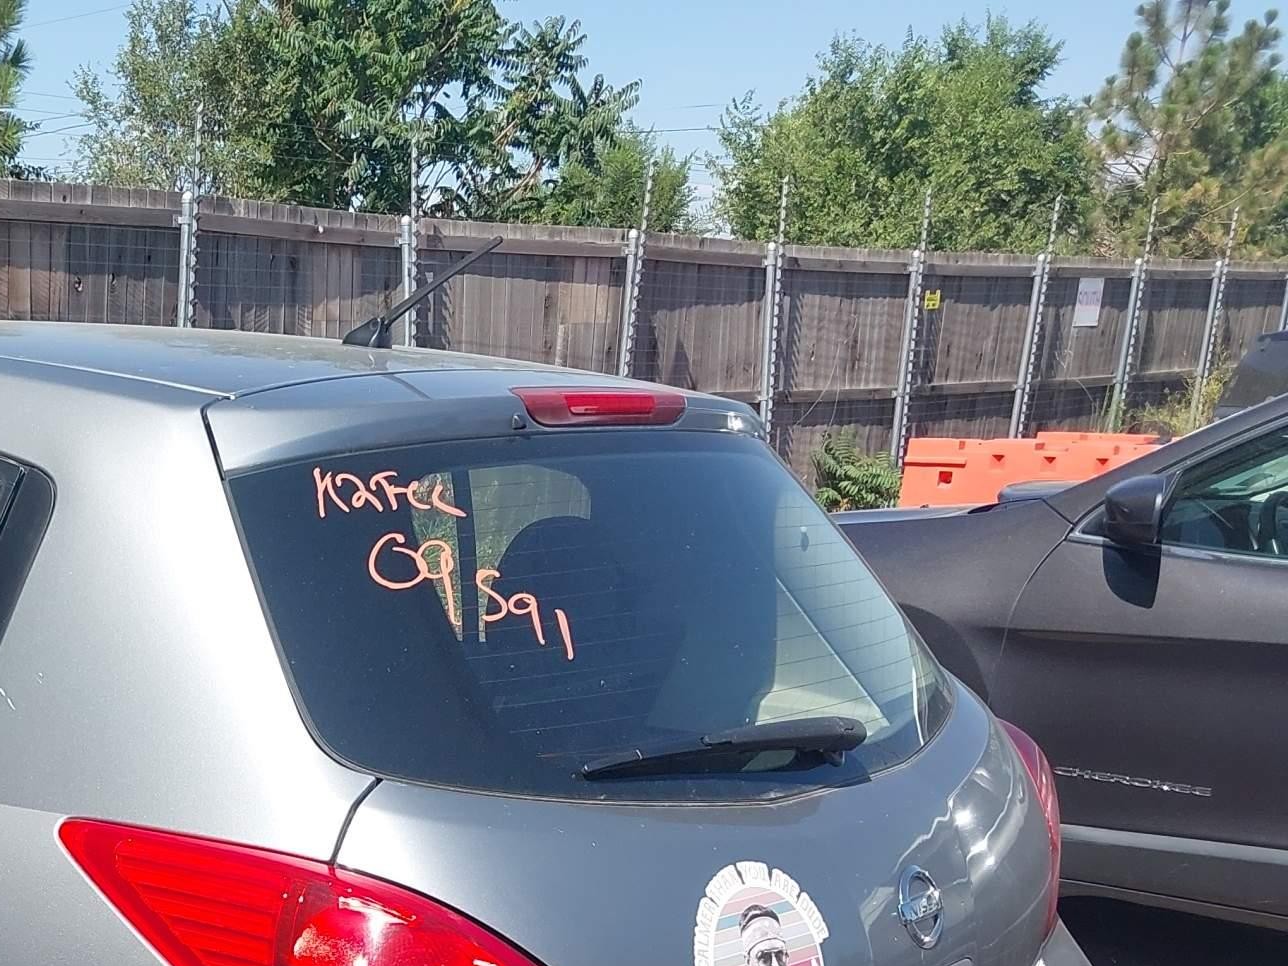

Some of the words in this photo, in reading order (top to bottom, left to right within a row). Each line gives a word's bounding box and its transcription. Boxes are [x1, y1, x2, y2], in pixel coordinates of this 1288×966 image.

[1053, 766, 1213, 797] CHEROKEE
[774, 873, 799, 899] ARE
[799, 897, 827, 939] DUDE
